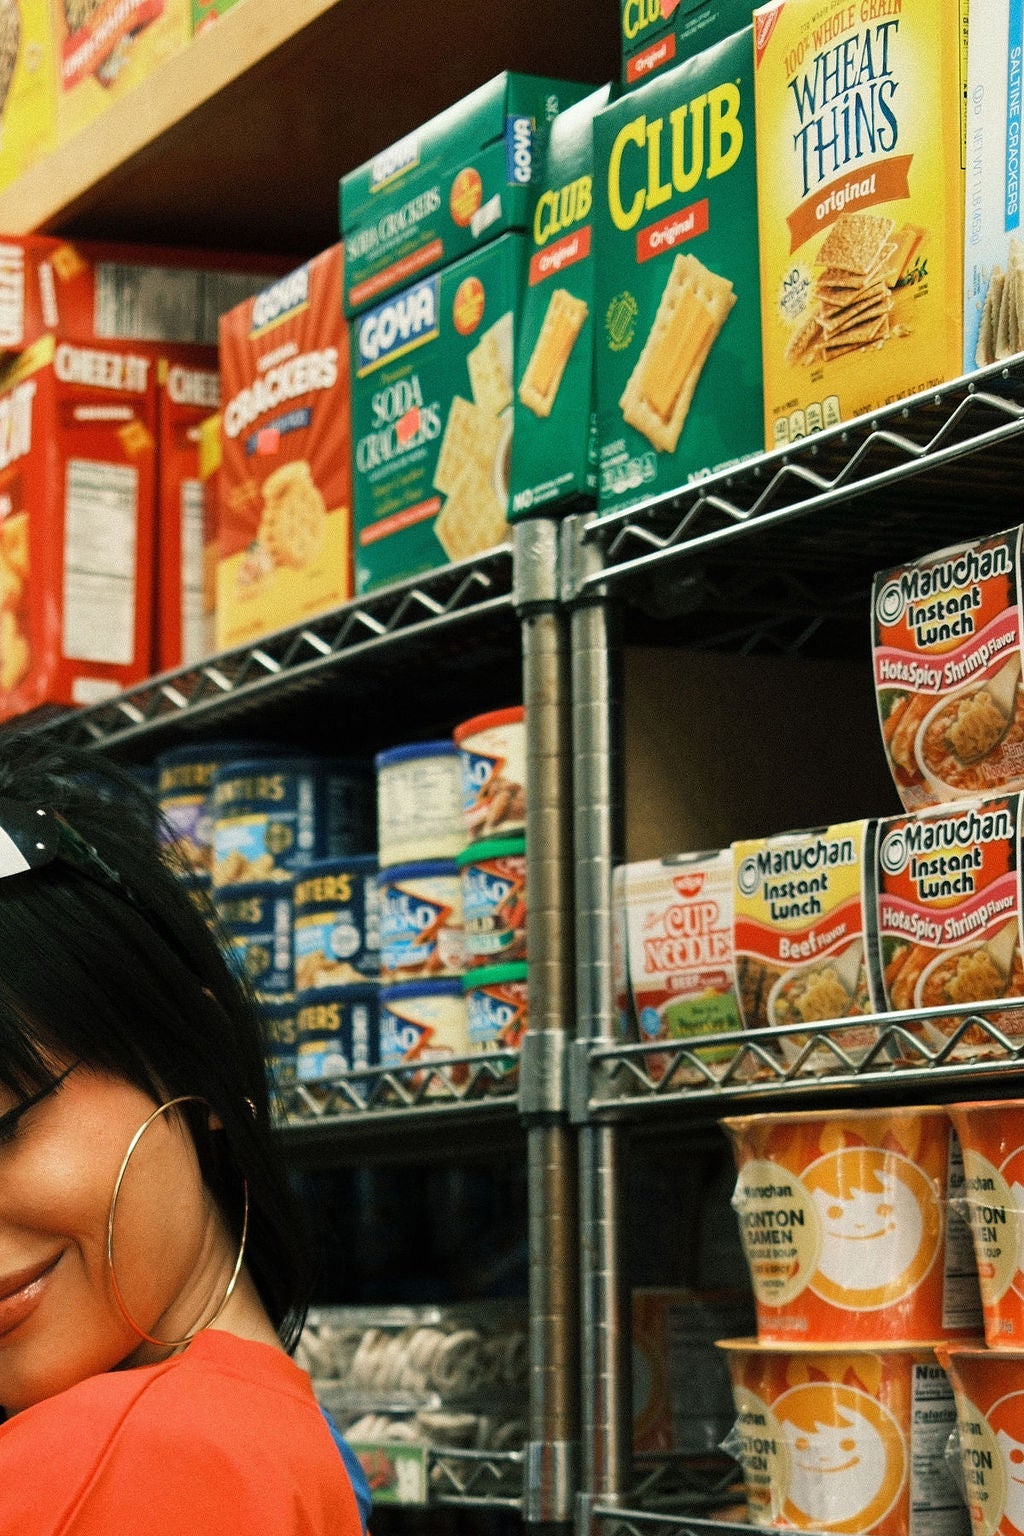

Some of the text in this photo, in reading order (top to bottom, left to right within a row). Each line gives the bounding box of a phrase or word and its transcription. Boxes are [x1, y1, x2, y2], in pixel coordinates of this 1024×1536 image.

[623, 0, 662, 39] CLU
[812, 4, 855, 51] WHOLE
[861, 0, 902, 23] GRAIN
[634, 43, 668, 73] Original
[787, 19, 900, 125] WHEAT
[514, 118, 532, 183] GOYA
[1007, 46, 1021, 217] SALTINE CRACKERS
[607, 82, 744, 231] CLUB
[533, 176, 593, 246] CLUB
[815, 174, 876, 220] original
[649, 213, 695, 248] Original
[539, 237, 579, 272] Original
[359, 287, 436, 360] GOYA
[223, 346, 339, 439] CRACKERS
[371, 374, 424, 429] SODA
[900, 546, 1007, 602] Maruchan
[908, 586, 981, 627] Instant
[916, 613, 974, 648] Lunch
[943, 643, 990, 686] Shrimp
[988, 630, 1017, 656] Flavor
[904, 809, 1009, 853] Maruchan
[755, 839, 853, 876] Maruchan
[910, 847, 982, 879] Instant
[763, 873, 828, 901] Instant
[918, 874, 974, 899] Lunch
[664, 900, 719, 937] CUP
[770, 898, 821, 921] Lunch
[943, 903, 989, 941] Shrimp
[988, 895, 1015, 917] Flavor
[778, 922, 848, 959] Beef Flavor
